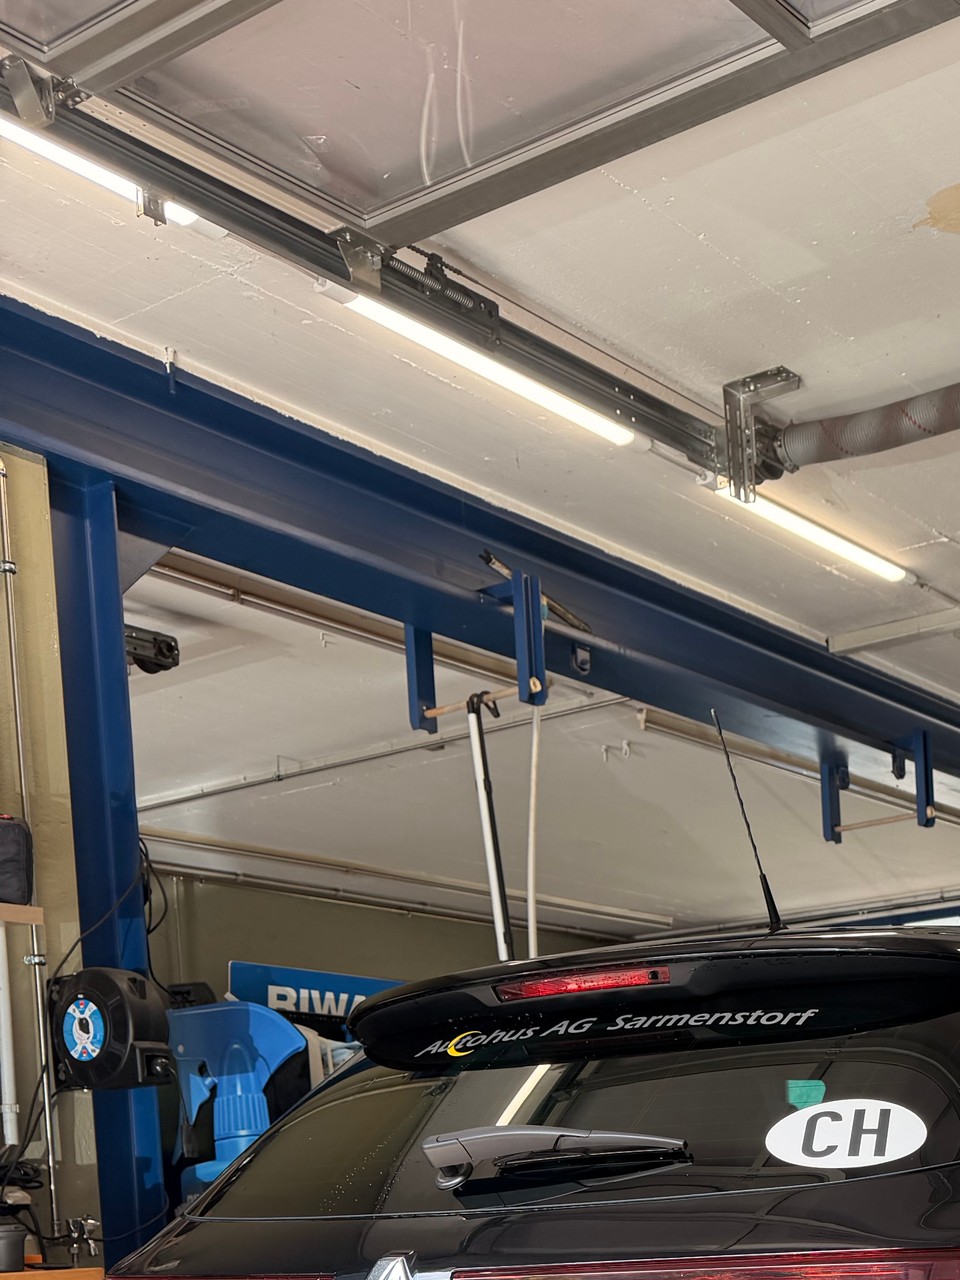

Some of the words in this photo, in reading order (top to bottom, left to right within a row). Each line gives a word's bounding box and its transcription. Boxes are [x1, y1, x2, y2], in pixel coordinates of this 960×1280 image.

[414, 1026, 545, 1058] Autohus
[539, 1017, 598, 1037] AG
[606, 1008, 819, 1031] Sarmenstorf
[801, 1108, 892, 1158] CH
